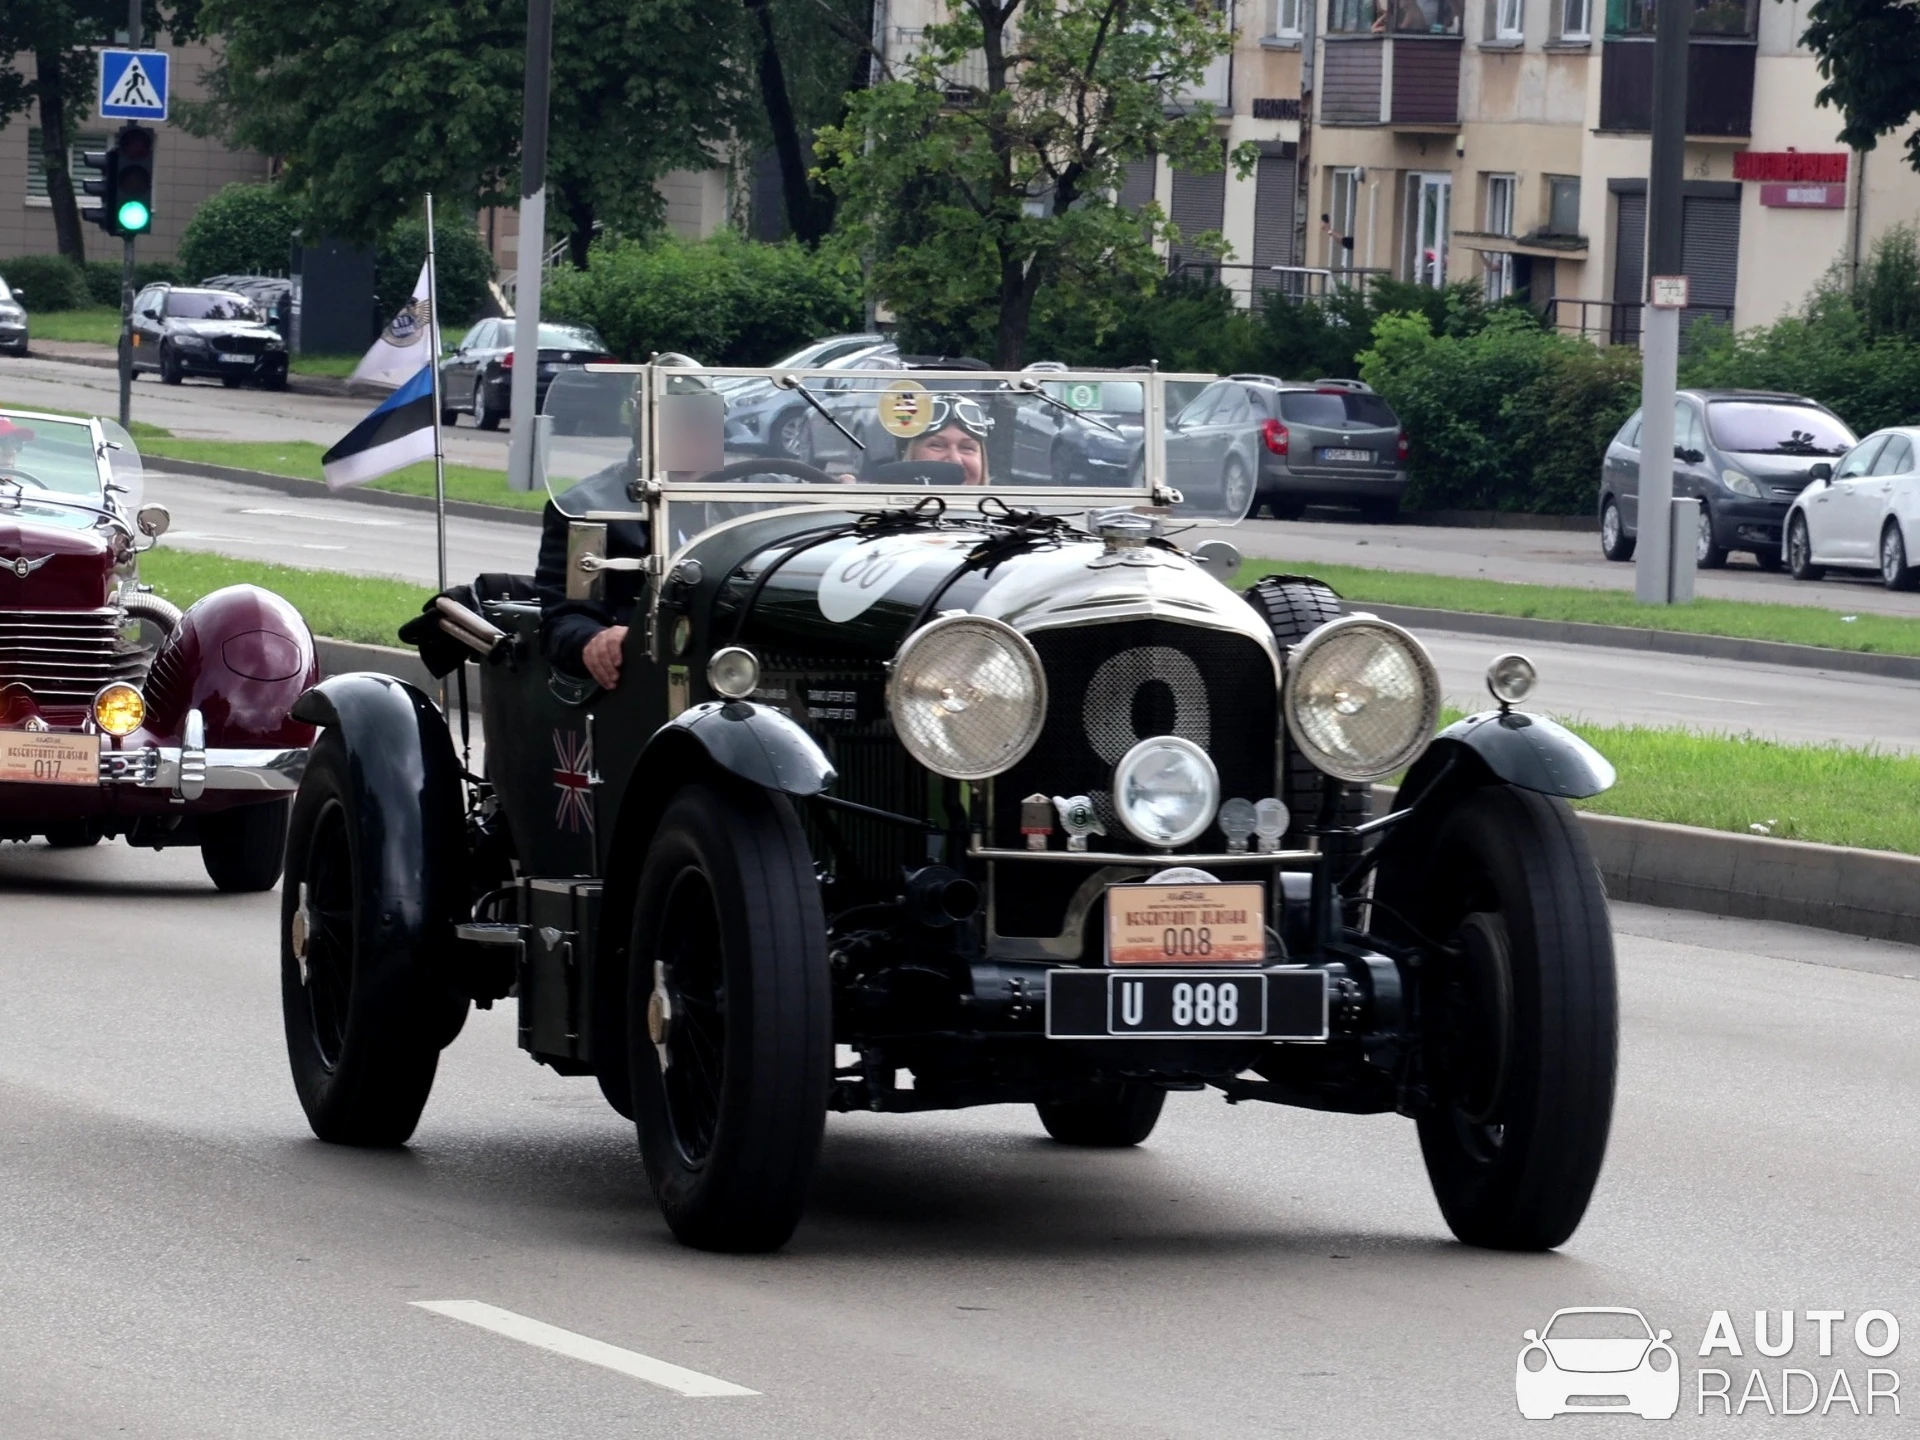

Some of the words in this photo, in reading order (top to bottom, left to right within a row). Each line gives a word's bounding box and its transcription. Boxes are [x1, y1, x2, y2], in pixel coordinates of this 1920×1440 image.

[34, 759, 62, 779] 017
[1163, 927, 1211, 956] 008
[1122, 982, 1143, 1026] U
[1172, 982, 1238, 1026] 888
